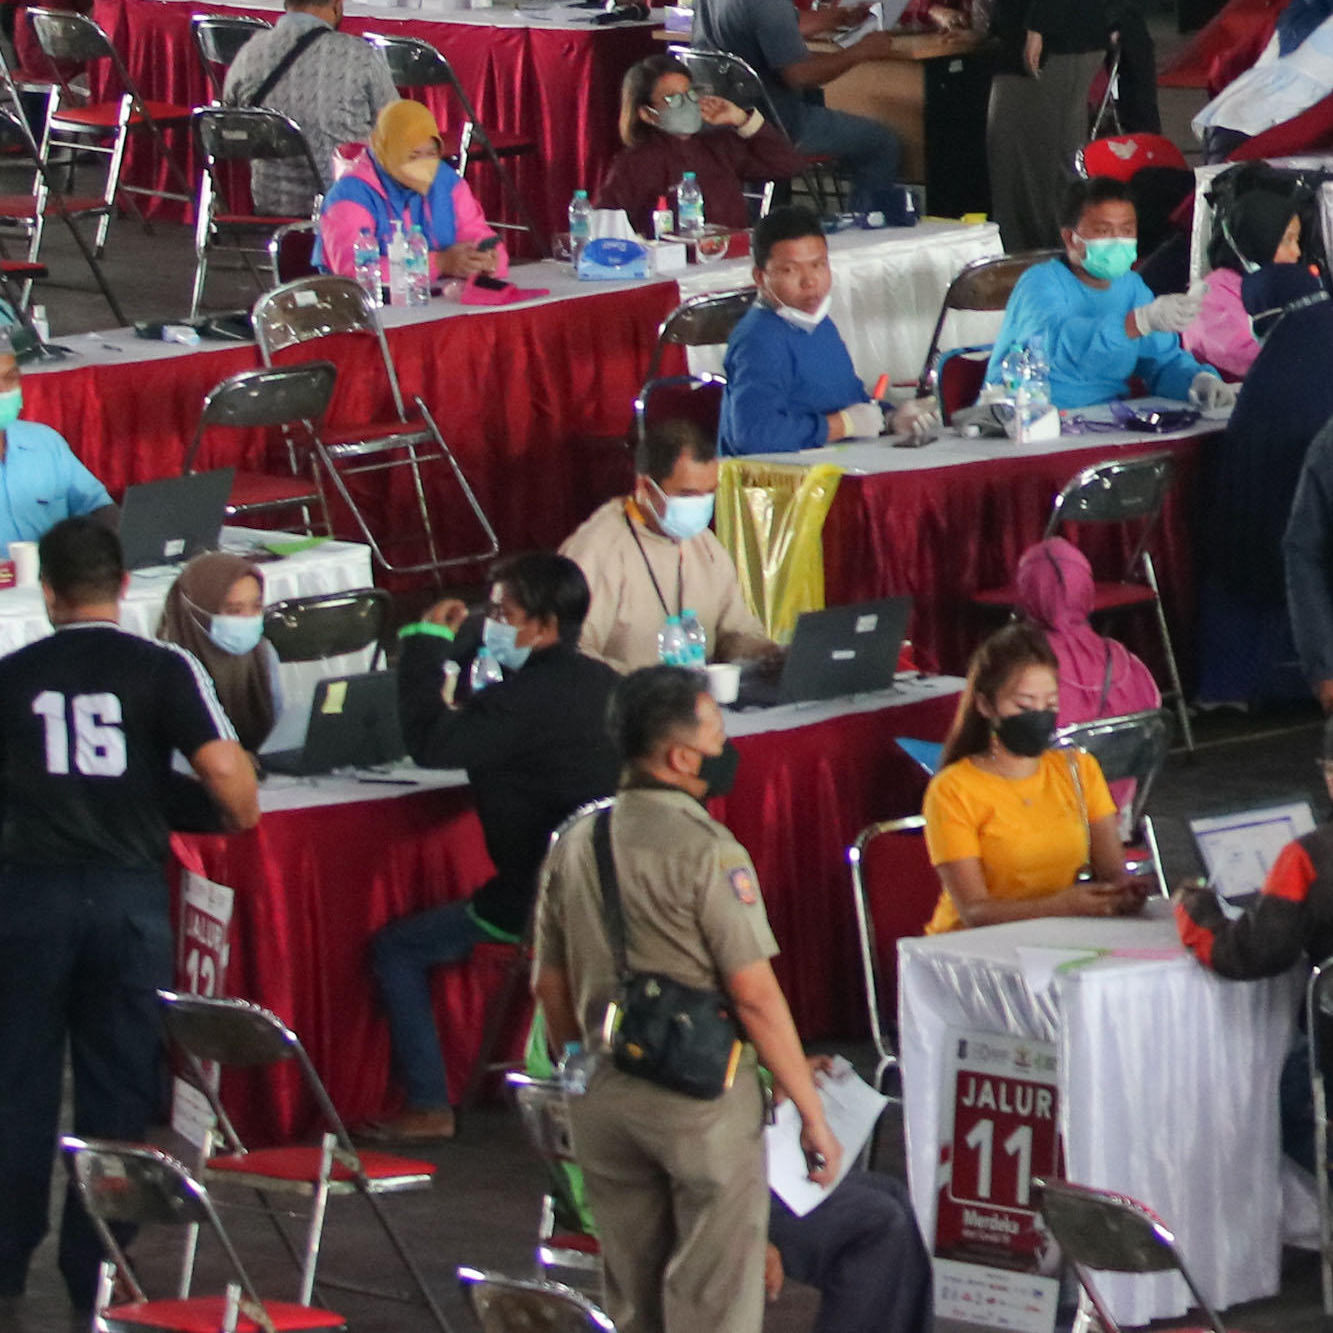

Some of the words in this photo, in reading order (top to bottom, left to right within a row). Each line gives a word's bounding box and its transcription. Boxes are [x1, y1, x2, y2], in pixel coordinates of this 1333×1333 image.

[33, 691, 128, 777] 16
[962, 1076, 1054, 1120] JALUR
[965, 1118, 1033, 1206] 11
